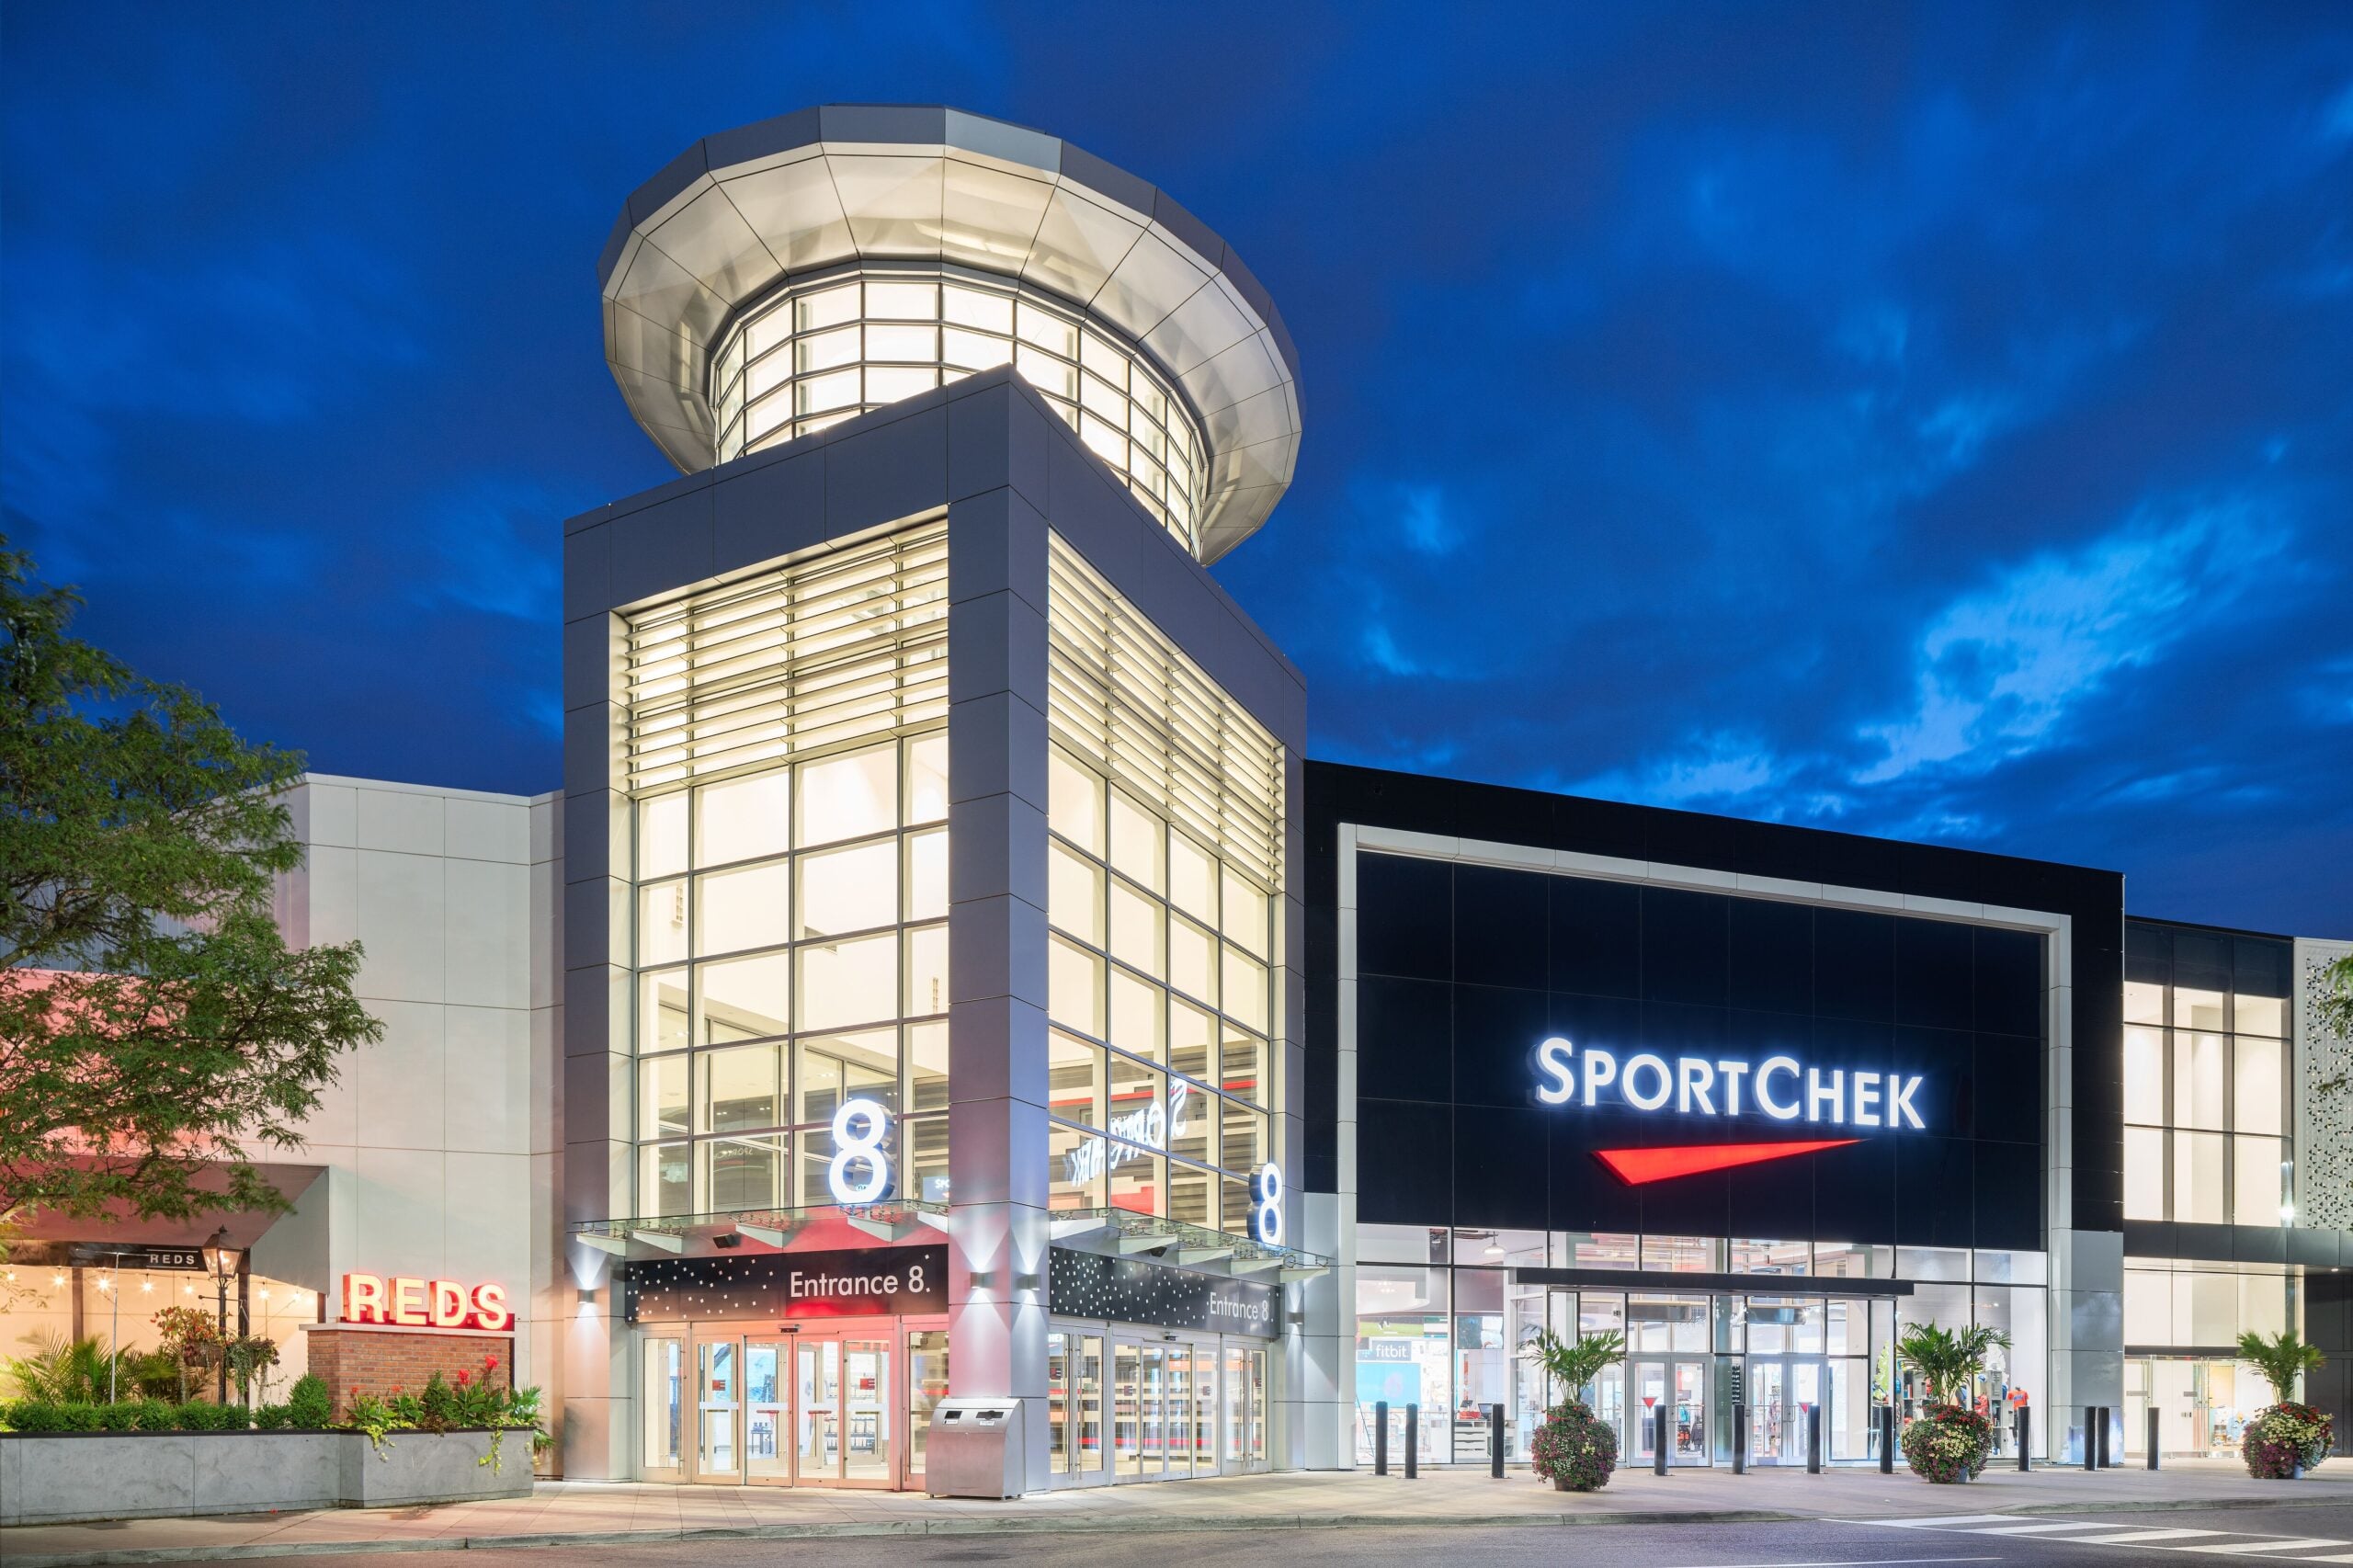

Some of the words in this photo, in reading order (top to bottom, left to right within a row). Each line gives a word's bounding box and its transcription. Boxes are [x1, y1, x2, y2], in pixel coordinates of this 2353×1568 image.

[1534, 1037, 1927, 1130] SPORTCHEK
[828, 1098, 888, 1204] 8
[1257, 1162, 1283, 1245] 8
[150, 1253, 195, 1265] REDS
[344, 1273, 507, 1330] REDS
[790, 1271, 899, 1298] Entrance
[1210, 1291, 1258, 1320] Entrance
[1261, 1300, 1268, 1322] 8
[1376, 1344, 1407, 1358] fitbit
